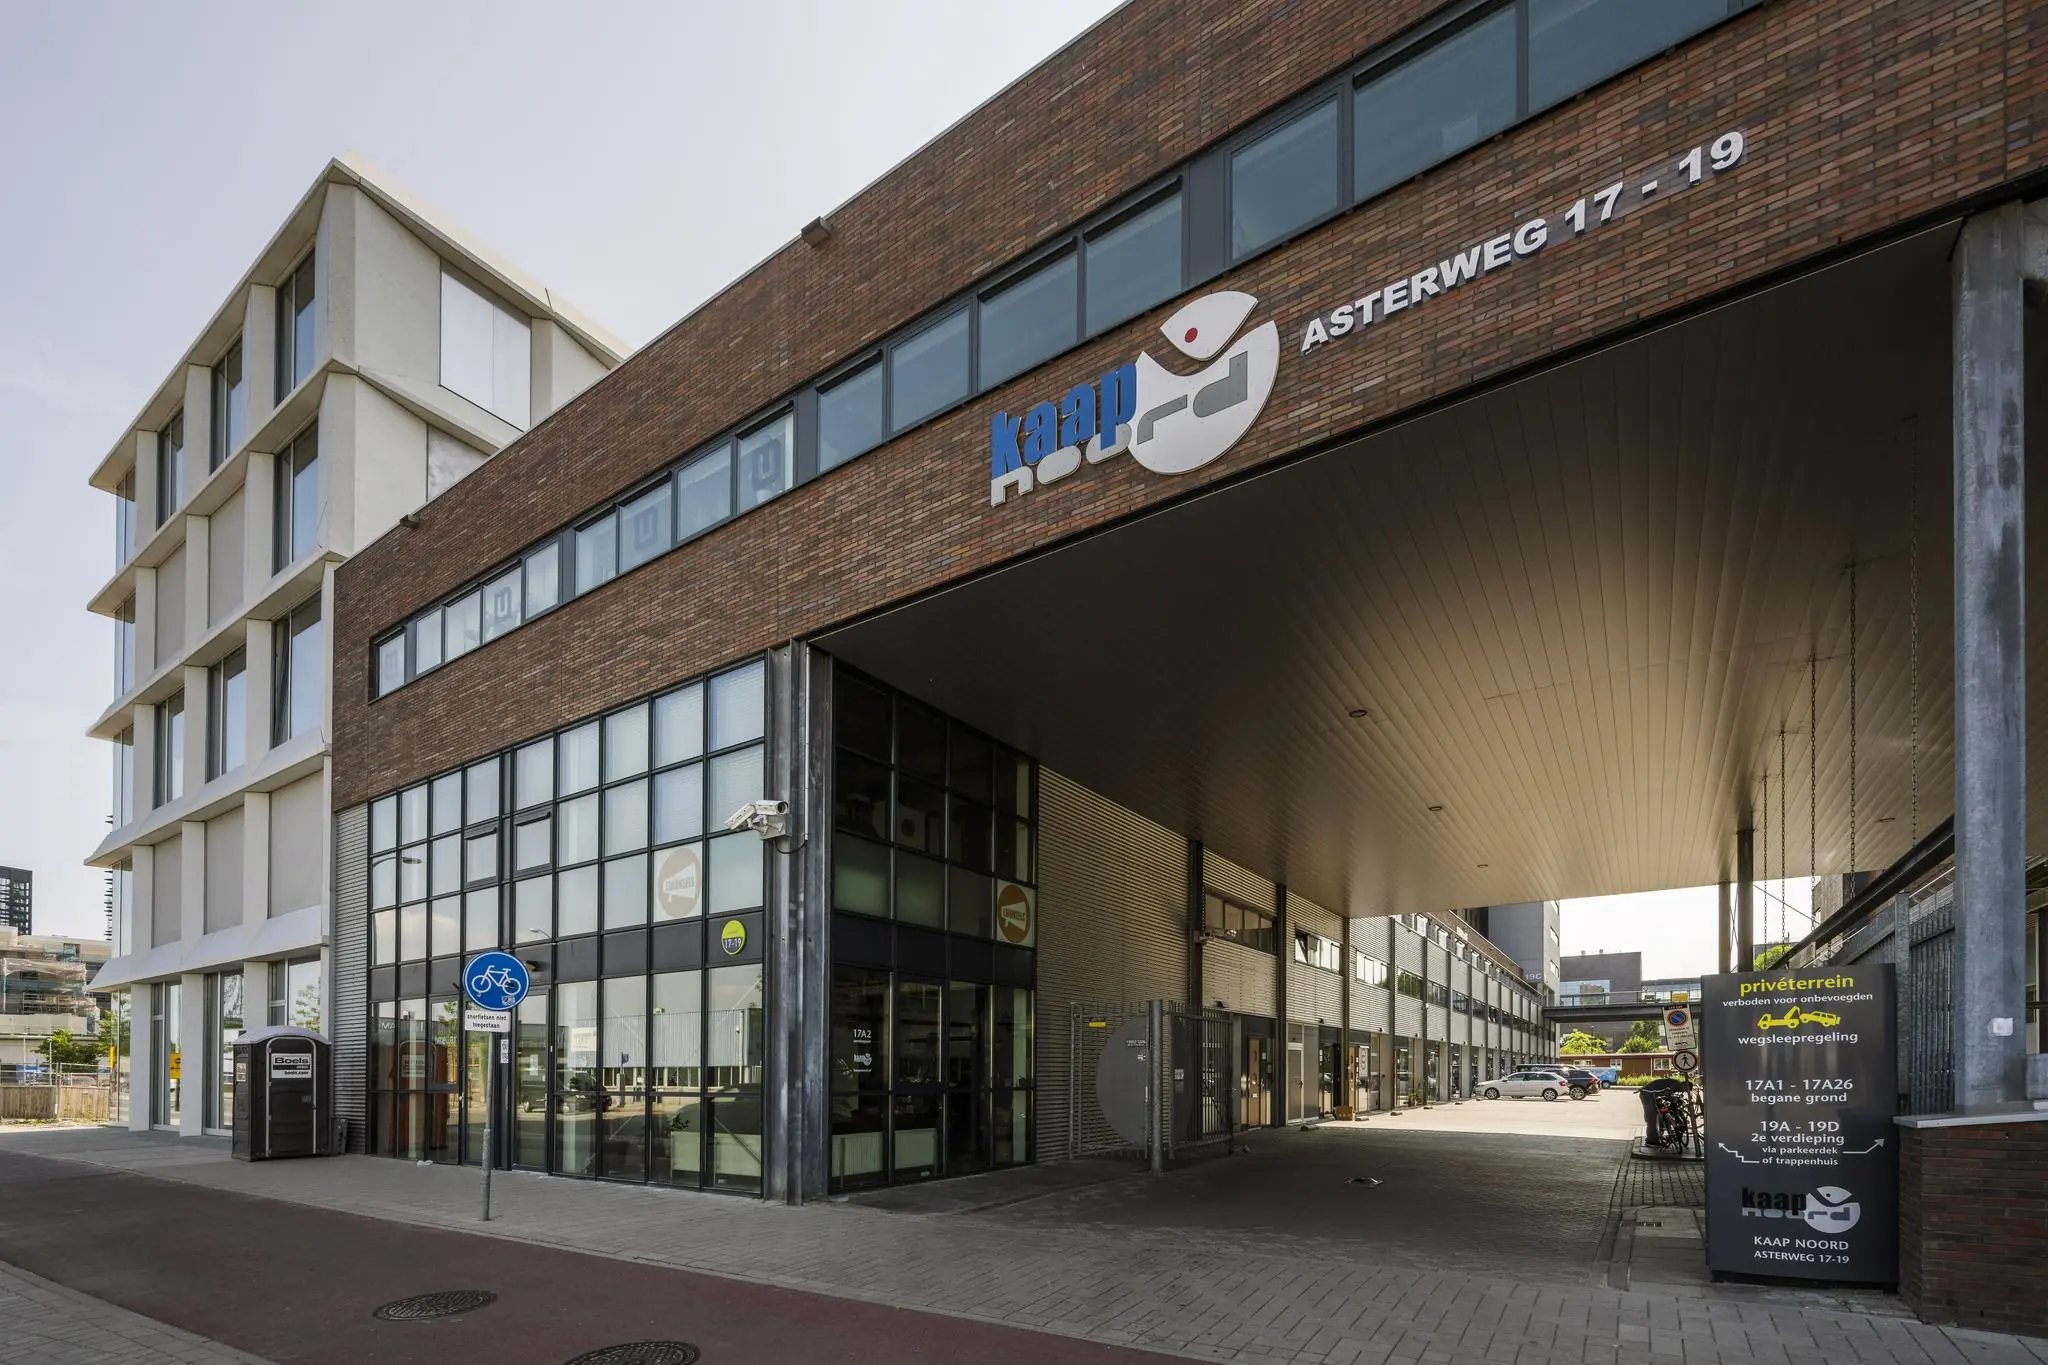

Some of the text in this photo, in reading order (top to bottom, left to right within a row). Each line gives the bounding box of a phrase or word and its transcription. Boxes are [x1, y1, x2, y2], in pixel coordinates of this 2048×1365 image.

[1301, 217, 1548, 354] ASTERWEG
[1564, 181, 1624, 234] 17
[1678, 131, 1745, 185] 19
[990, 362, 1137, 481] kaap
[724, 938, 742, 948] 17-19
[1740, 975, 1854, 997] privéterrein
[1722, 993, 1873, 1007] verboden voor onbevoegden
[853, 1029, 872, 1039] 17A2
[1738, 1032, 1858, 1046] wegsleepregeling
[1745, 1080, 1783, 1090] 17A1
[1803, 1079, 1853, 1090] 17A26
[1751, 1092, 1847, 1105] begane grond
[1760, 1121, 1790, 1132] 19A
[1808, 1121, 1840, 1132] 19D
[1751, 1133, 1845, 1146] 2e verdieping
[1762, 1145, 1838, 1155] via parkeerdek
[1776, 1157, 1838, 1167] trappenhuis
[1742, 1187, 1807, 1216] kaap
[1754, 1236, 1849, 1251] KAAP NOORD
[1754, 1250, 1850, 1264] ASTERWEG 17-19
